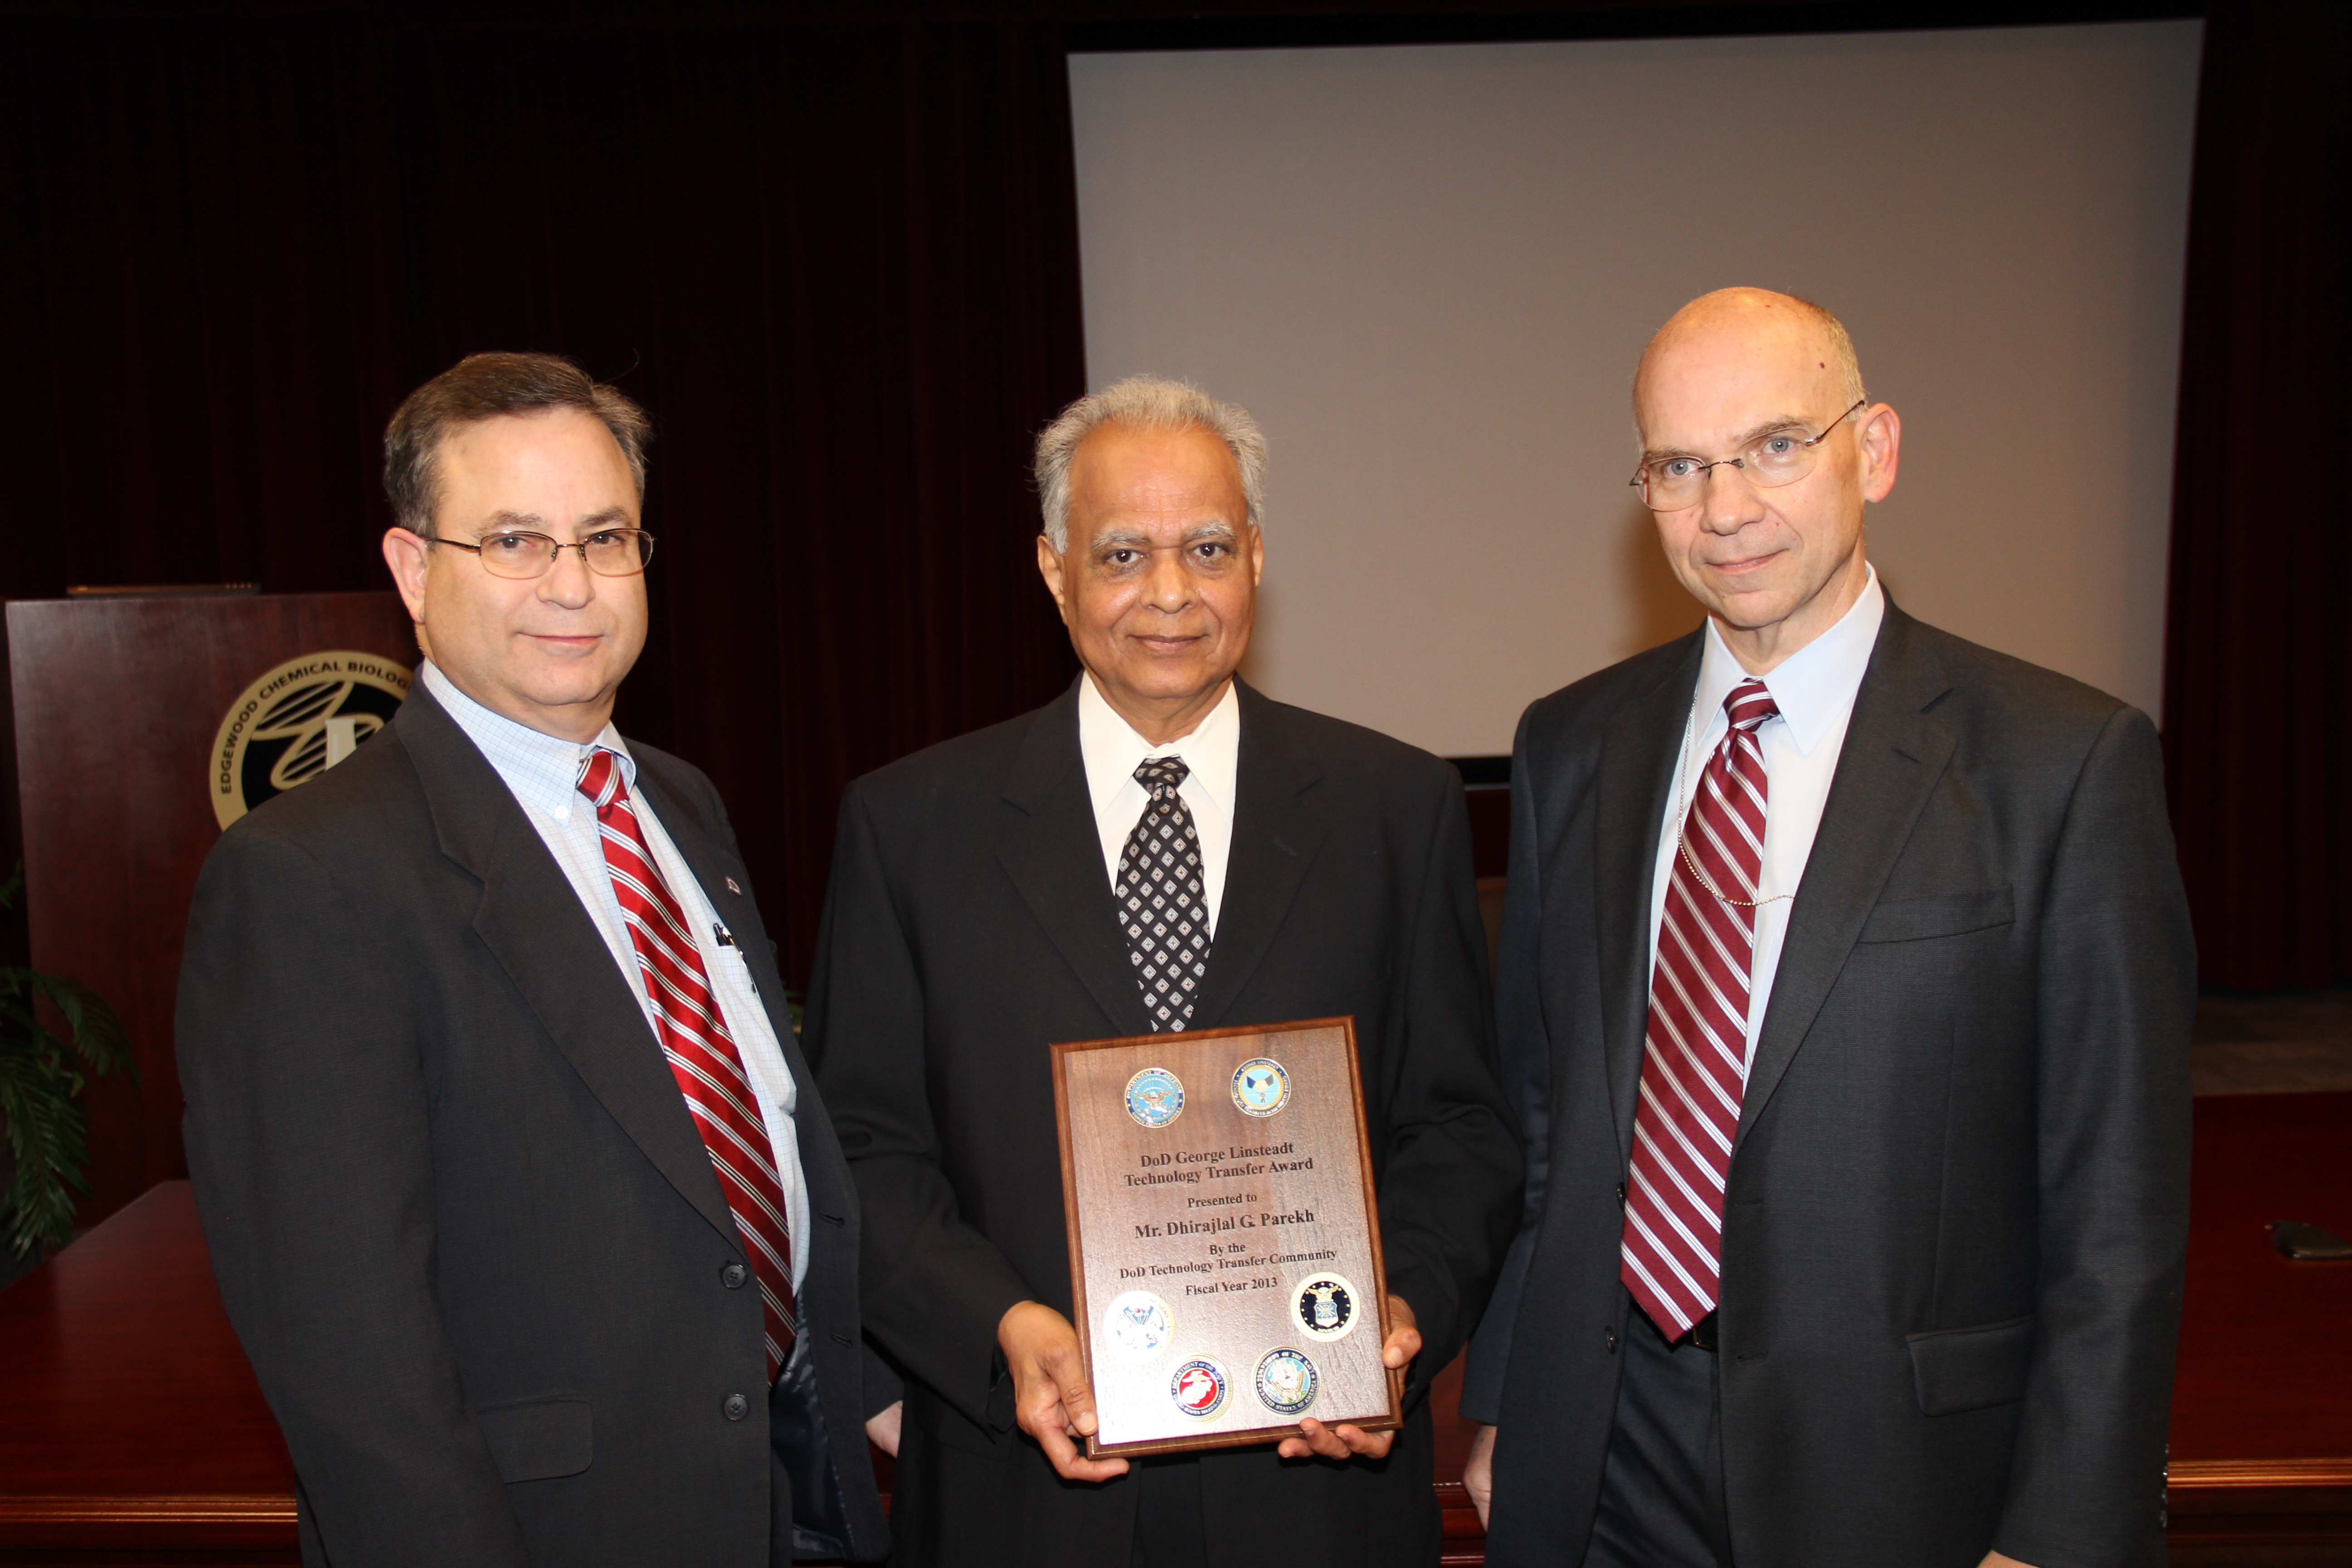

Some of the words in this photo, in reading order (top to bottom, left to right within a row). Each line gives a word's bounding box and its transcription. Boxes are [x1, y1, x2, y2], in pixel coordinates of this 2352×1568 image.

[221, 701, 259, 794] EDGEWOOD
[260, 661, 342, 700] CHEMICAL
[1141, 1153, 1171, 1167] DoD
[1176, 1151, 1225, 1164] George
[1229, 1142, 1294, 1158] Linsteadt
[1124, 1170, 1202, 1186] Technology
[1205, 1163, 1265, 1179] Transfer
[1269, 1157, 1314, 1173] Award
[1187, 1193, 1243, 1208] Presented
[1246, 1194, 1257, 1203] to
[1135, 1224, 1162, 1239] Mr.
[1166, 1216, 1236, 1235] Dhirajlal
[1240, 1215, 1256, 1228] G.
[1260, 1209, 1315, 1226] Parekh
[1209, 1244, 1225, 1257] By
[1228, 1243, 1246, 1253] the
[1120, 1266, 1146, 1279] DoD
[1149, 1262, 1214, 1276] Technology
[1217, 1255, 1266, 1269] Transfer
[1269, 1249, 1337, 1264] Community
[1185, 1283, 1219, 1295] Fiscal
[1221, 1281, 1248, 1292] Year
[1251, 1277, 1278, 1289] 2013
[1291, 1352, 1303, 1361] THE
[1172, 1362, 1199, 1389] DEPARTMENT
[1305, 1381, 1317, 1404] AMERICA
